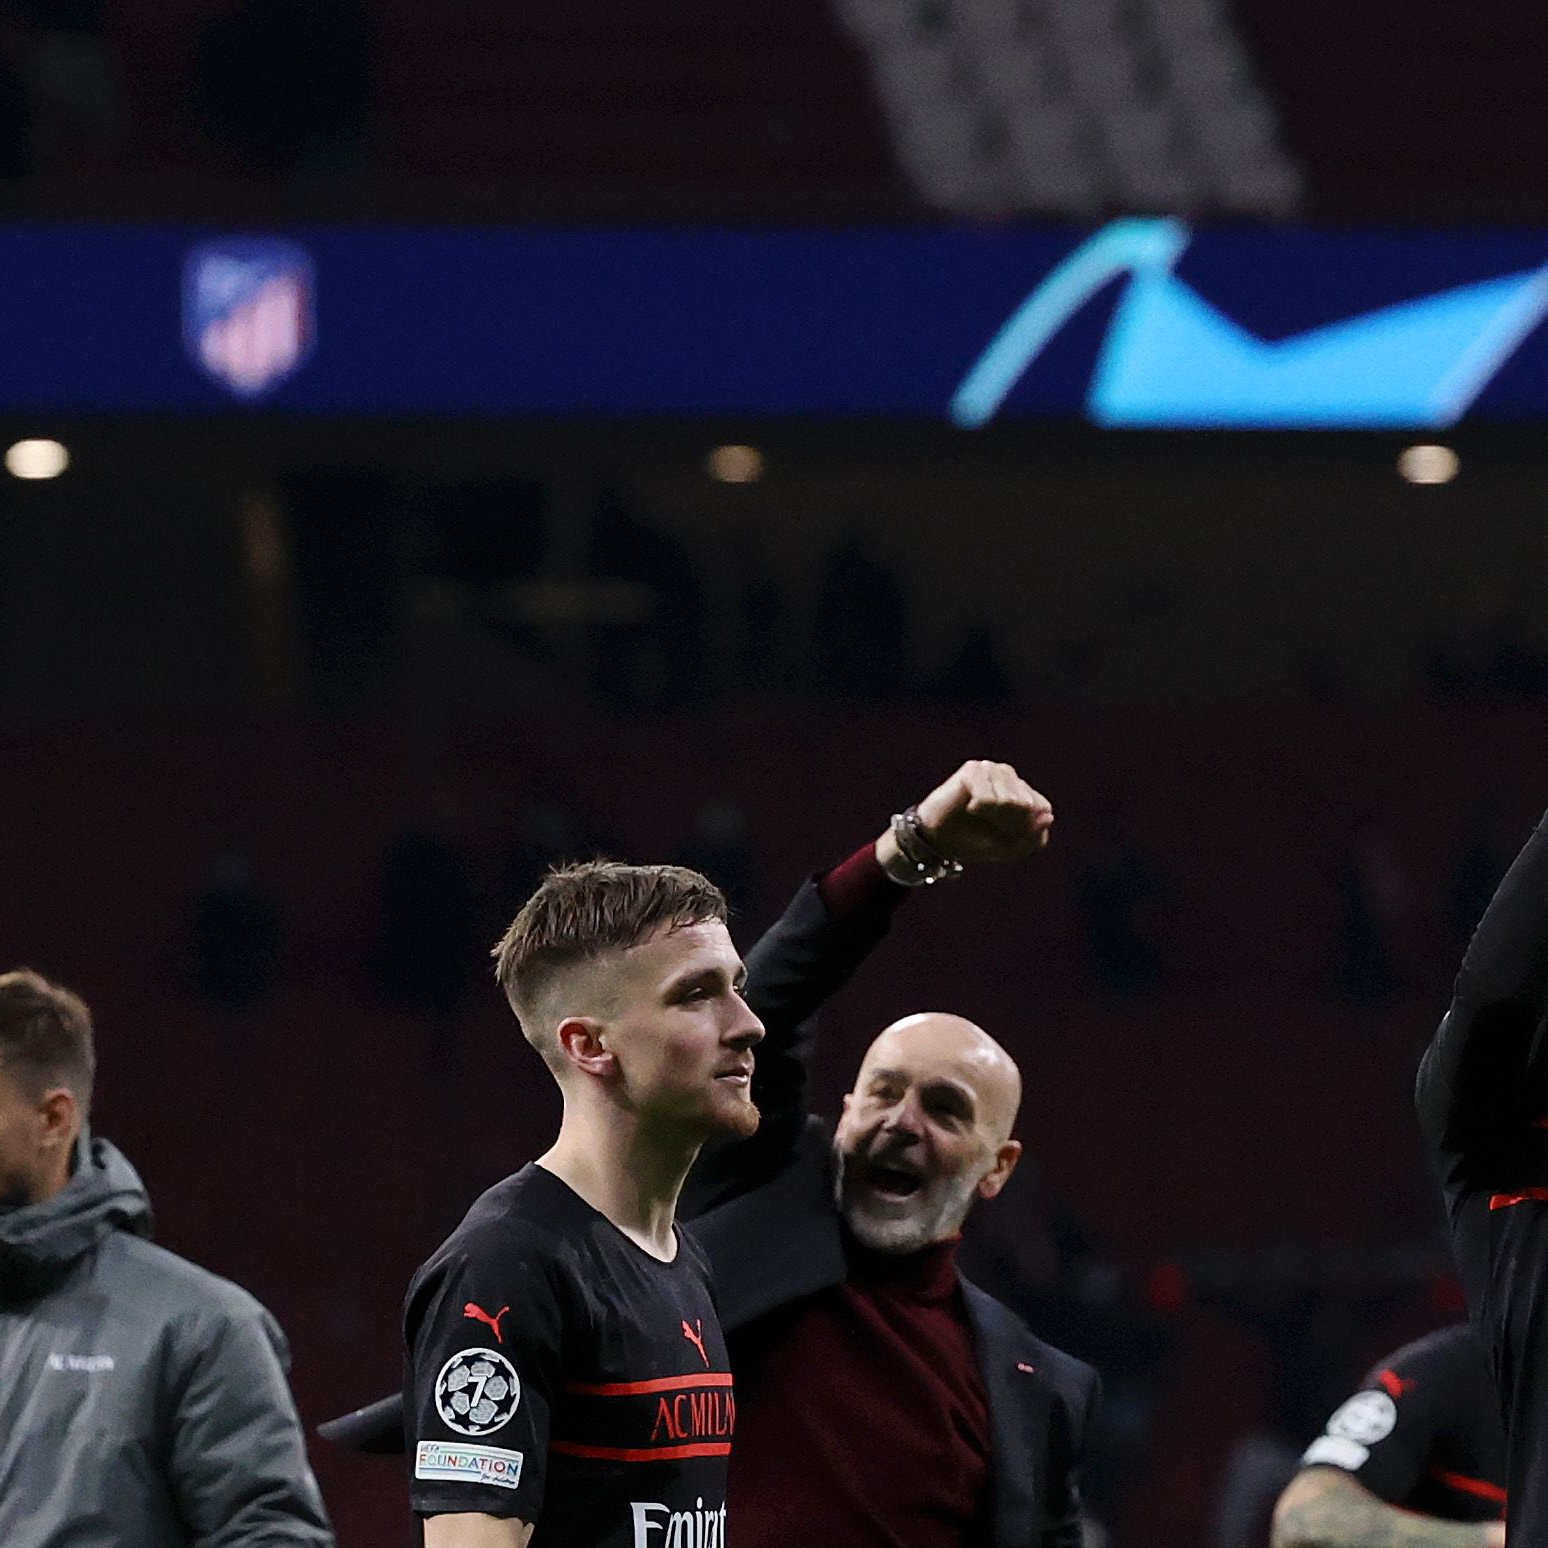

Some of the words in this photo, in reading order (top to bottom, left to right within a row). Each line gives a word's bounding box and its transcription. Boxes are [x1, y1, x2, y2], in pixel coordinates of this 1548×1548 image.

[467, 1376, 488, 1408] 7
[651, 1394, 689, 1441] AC
[419, 1452, 519, 1477] FOUNDATION
